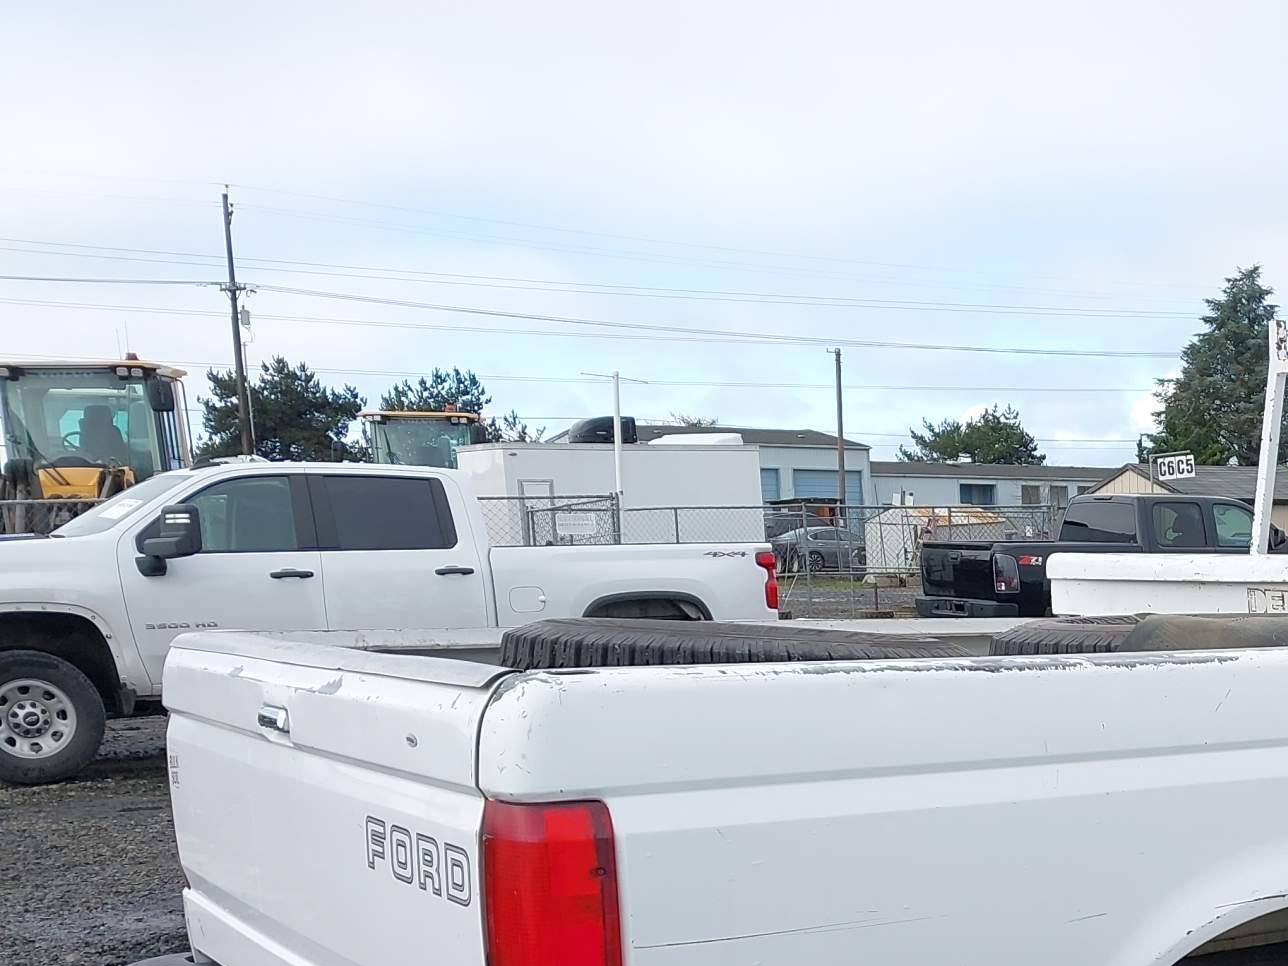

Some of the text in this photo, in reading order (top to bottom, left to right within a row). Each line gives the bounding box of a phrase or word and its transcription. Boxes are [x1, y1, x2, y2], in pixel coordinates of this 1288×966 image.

[1159, 458, 1194, 477] C6 C5
[365, 815, 472, 907] FORD
